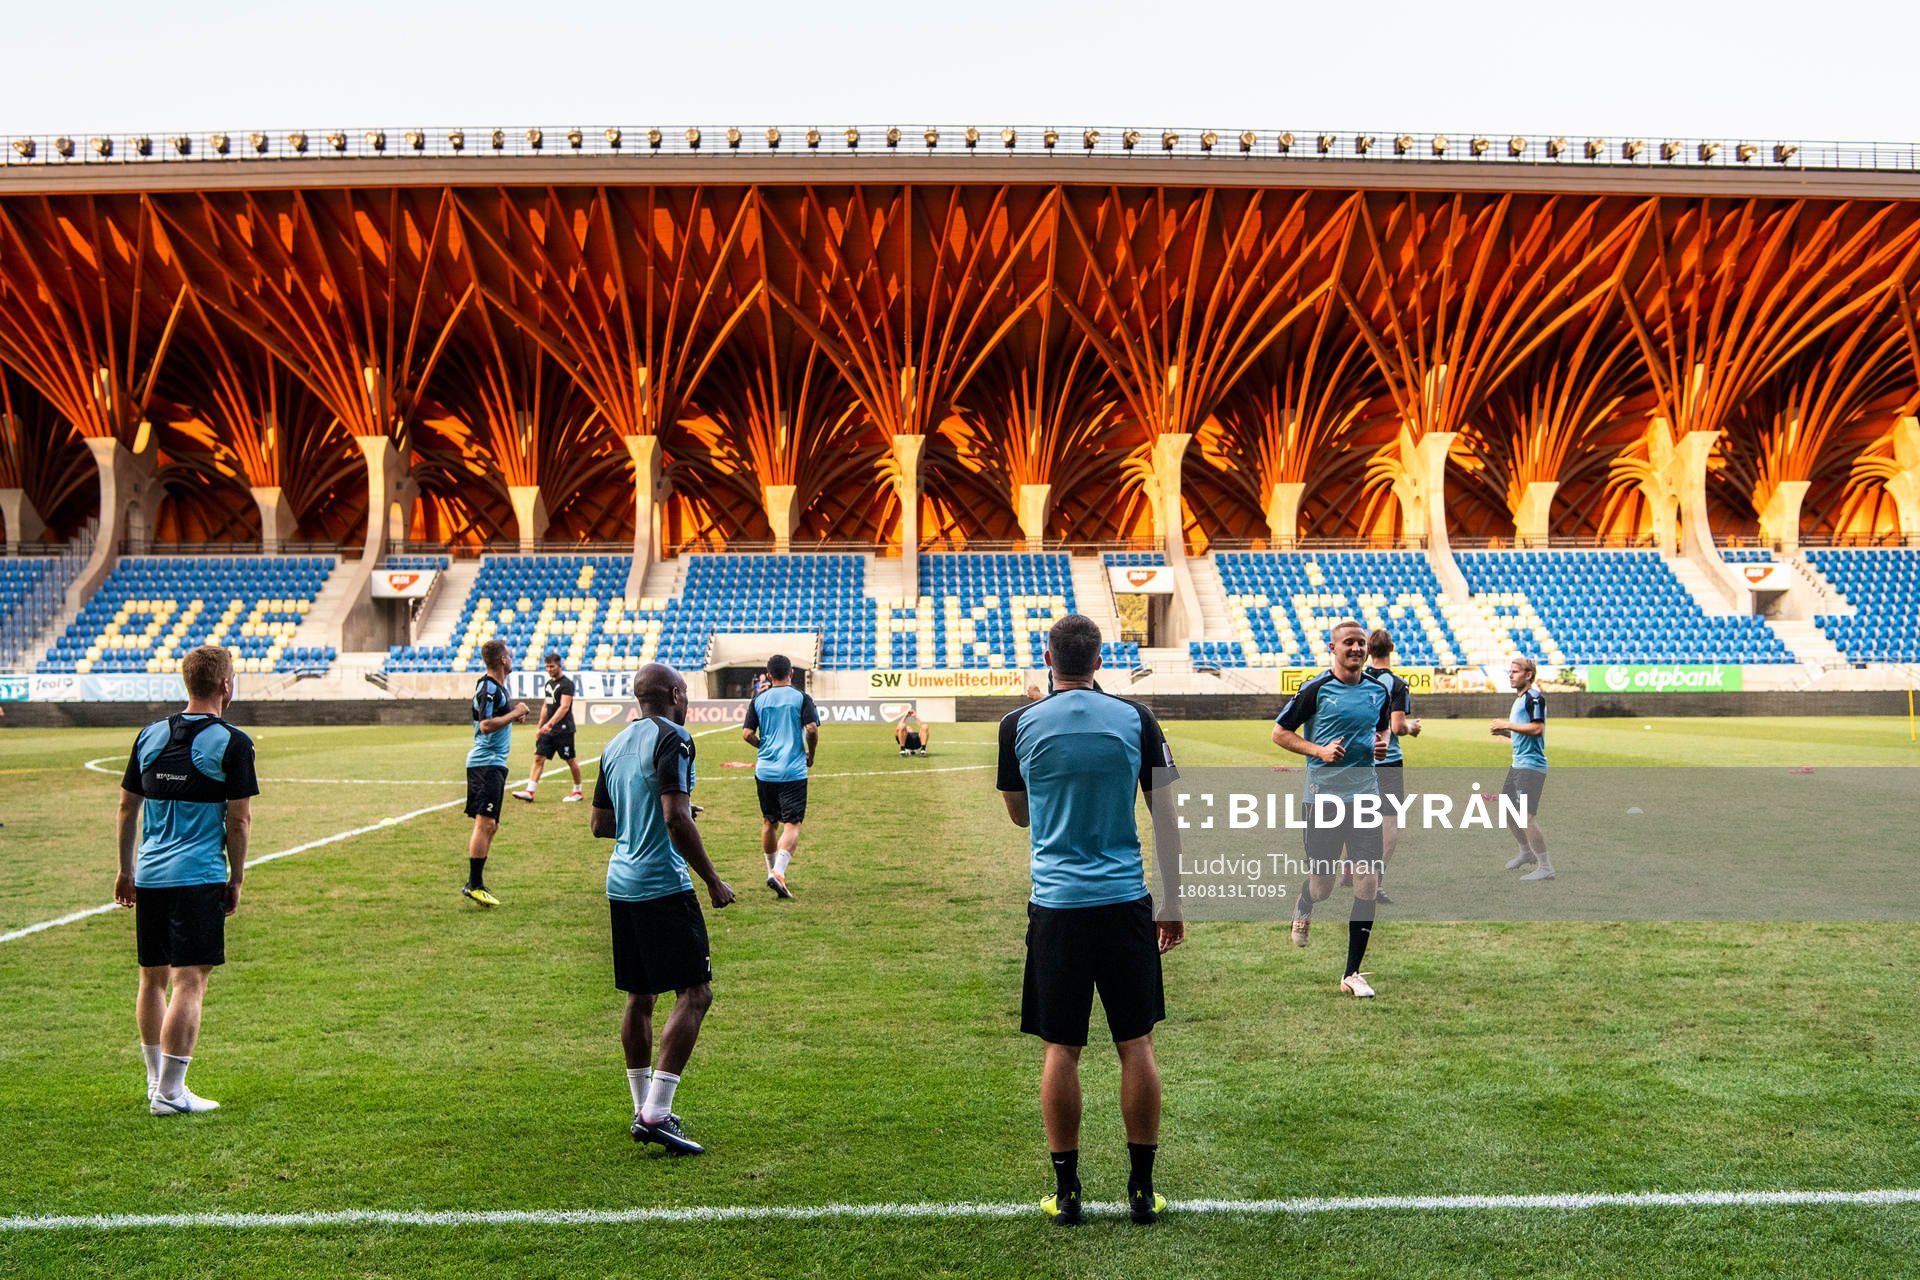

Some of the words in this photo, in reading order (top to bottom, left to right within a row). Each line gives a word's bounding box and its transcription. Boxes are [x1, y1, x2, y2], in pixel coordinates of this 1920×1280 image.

[871, 674, 901, 687] SW
[908, 672, 1022, 687] Umwelttechnik
[1634, 665, 1725, 692] otpbank
[832, 706, 875, 721] VAN.
